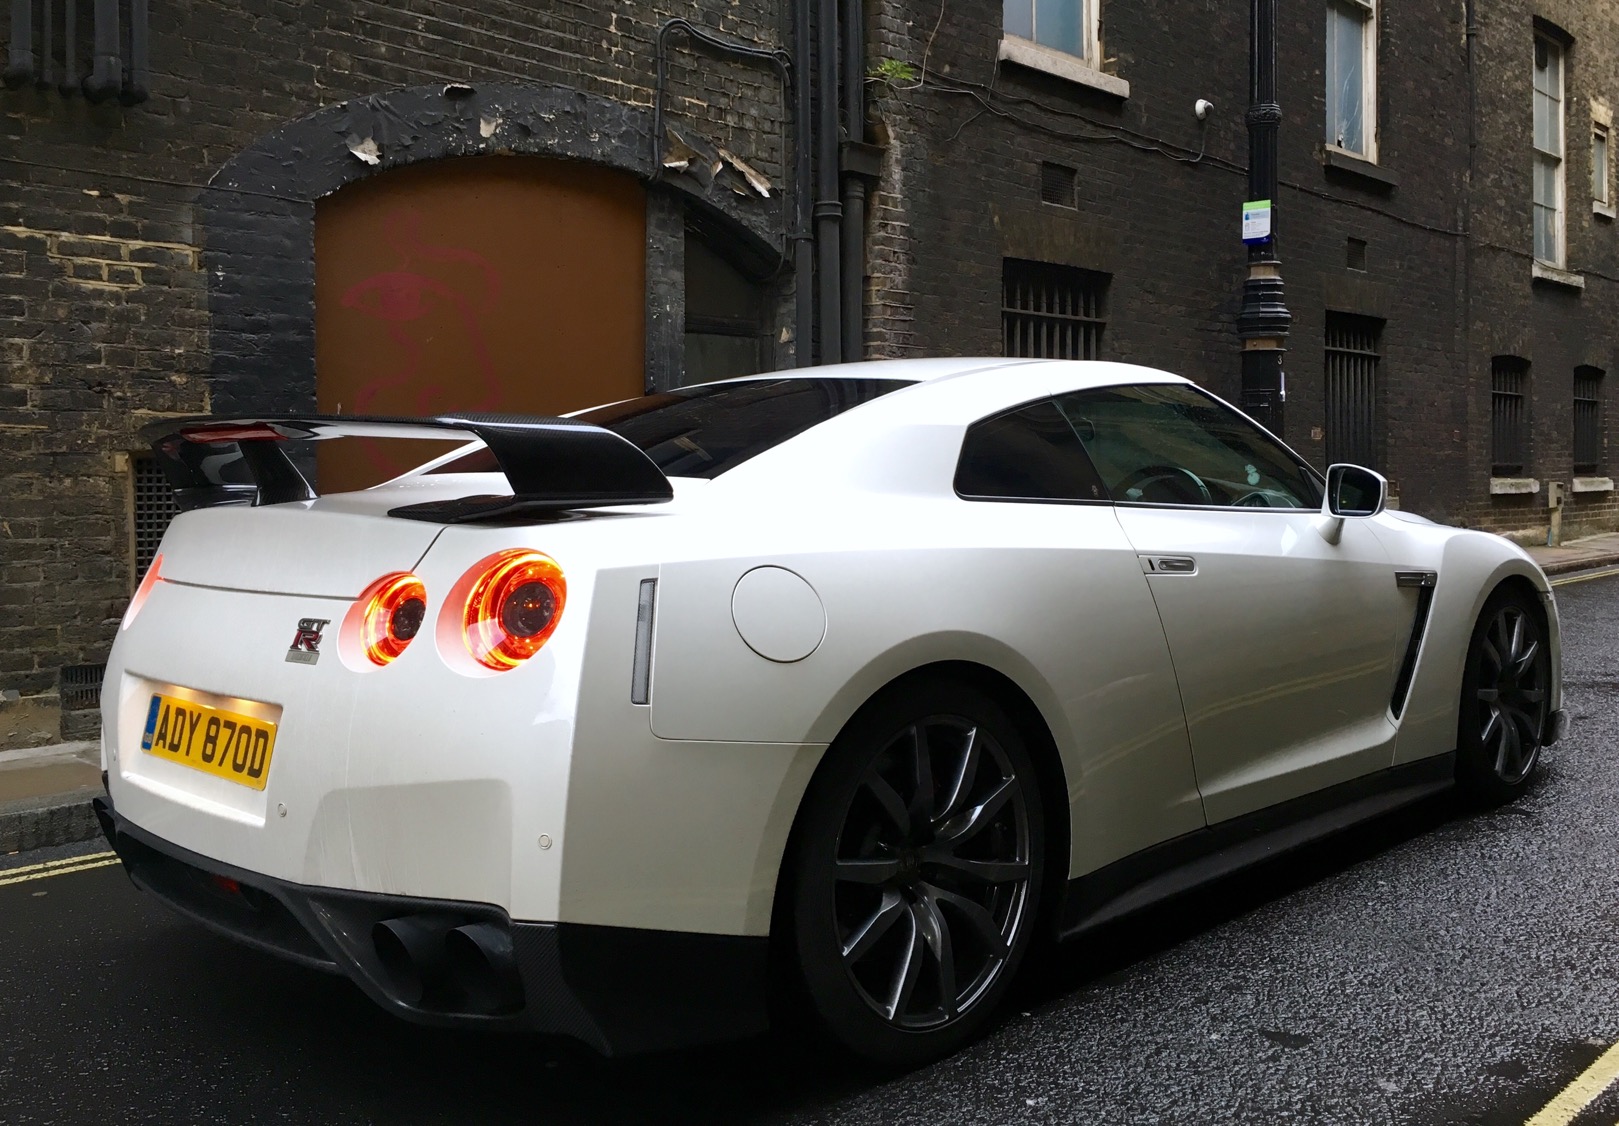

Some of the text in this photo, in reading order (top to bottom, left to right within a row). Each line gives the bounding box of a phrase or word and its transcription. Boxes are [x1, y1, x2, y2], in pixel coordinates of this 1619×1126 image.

[290, 629, 322, 652] R
[155, 704, 269, 778] ADY 870D
